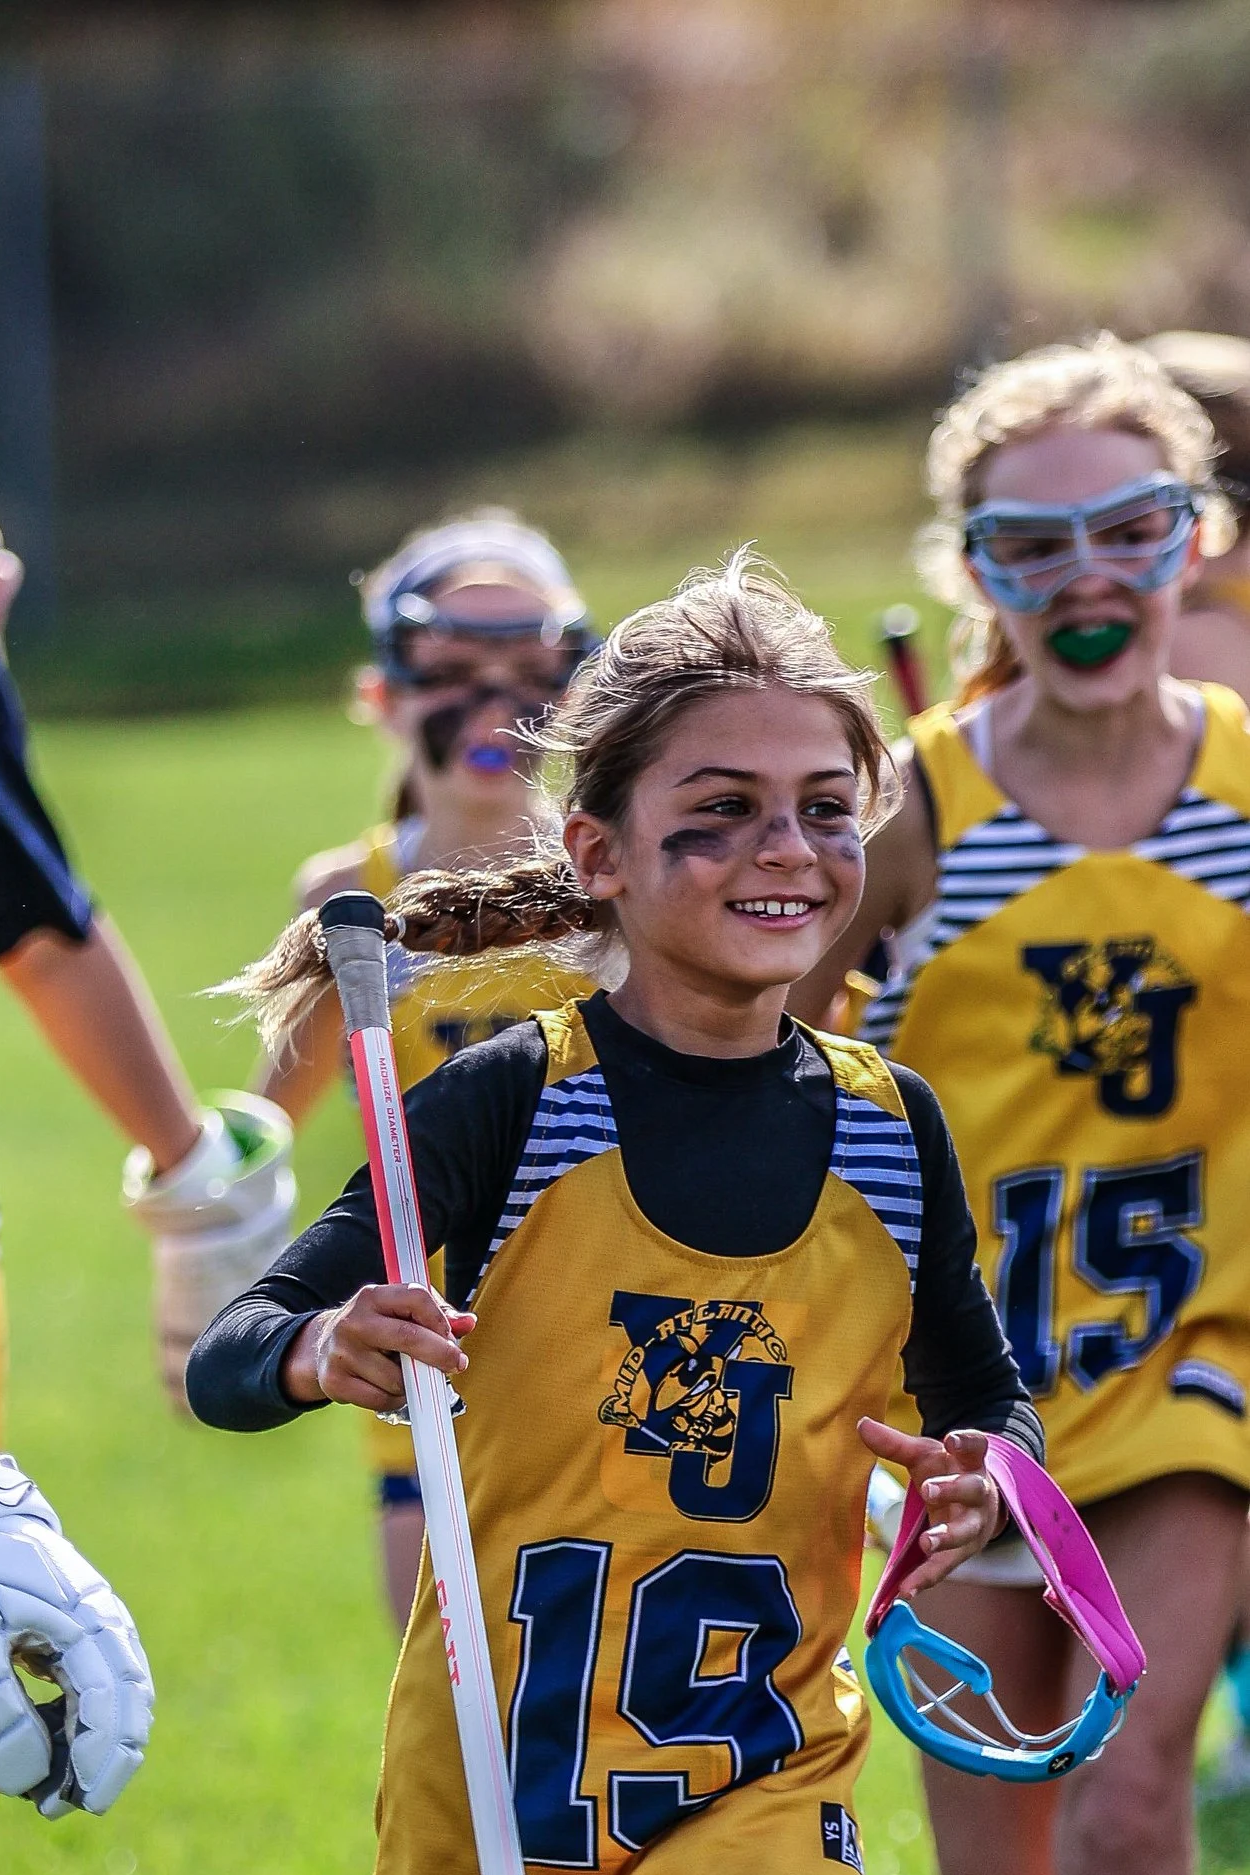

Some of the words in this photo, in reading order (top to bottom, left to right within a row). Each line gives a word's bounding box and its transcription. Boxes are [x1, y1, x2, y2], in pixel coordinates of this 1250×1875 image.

[992, 1150, 1205, 1400] 15
[508, 1536, 804, 1870] 19
[824, 1821, 840, 1841] YS
